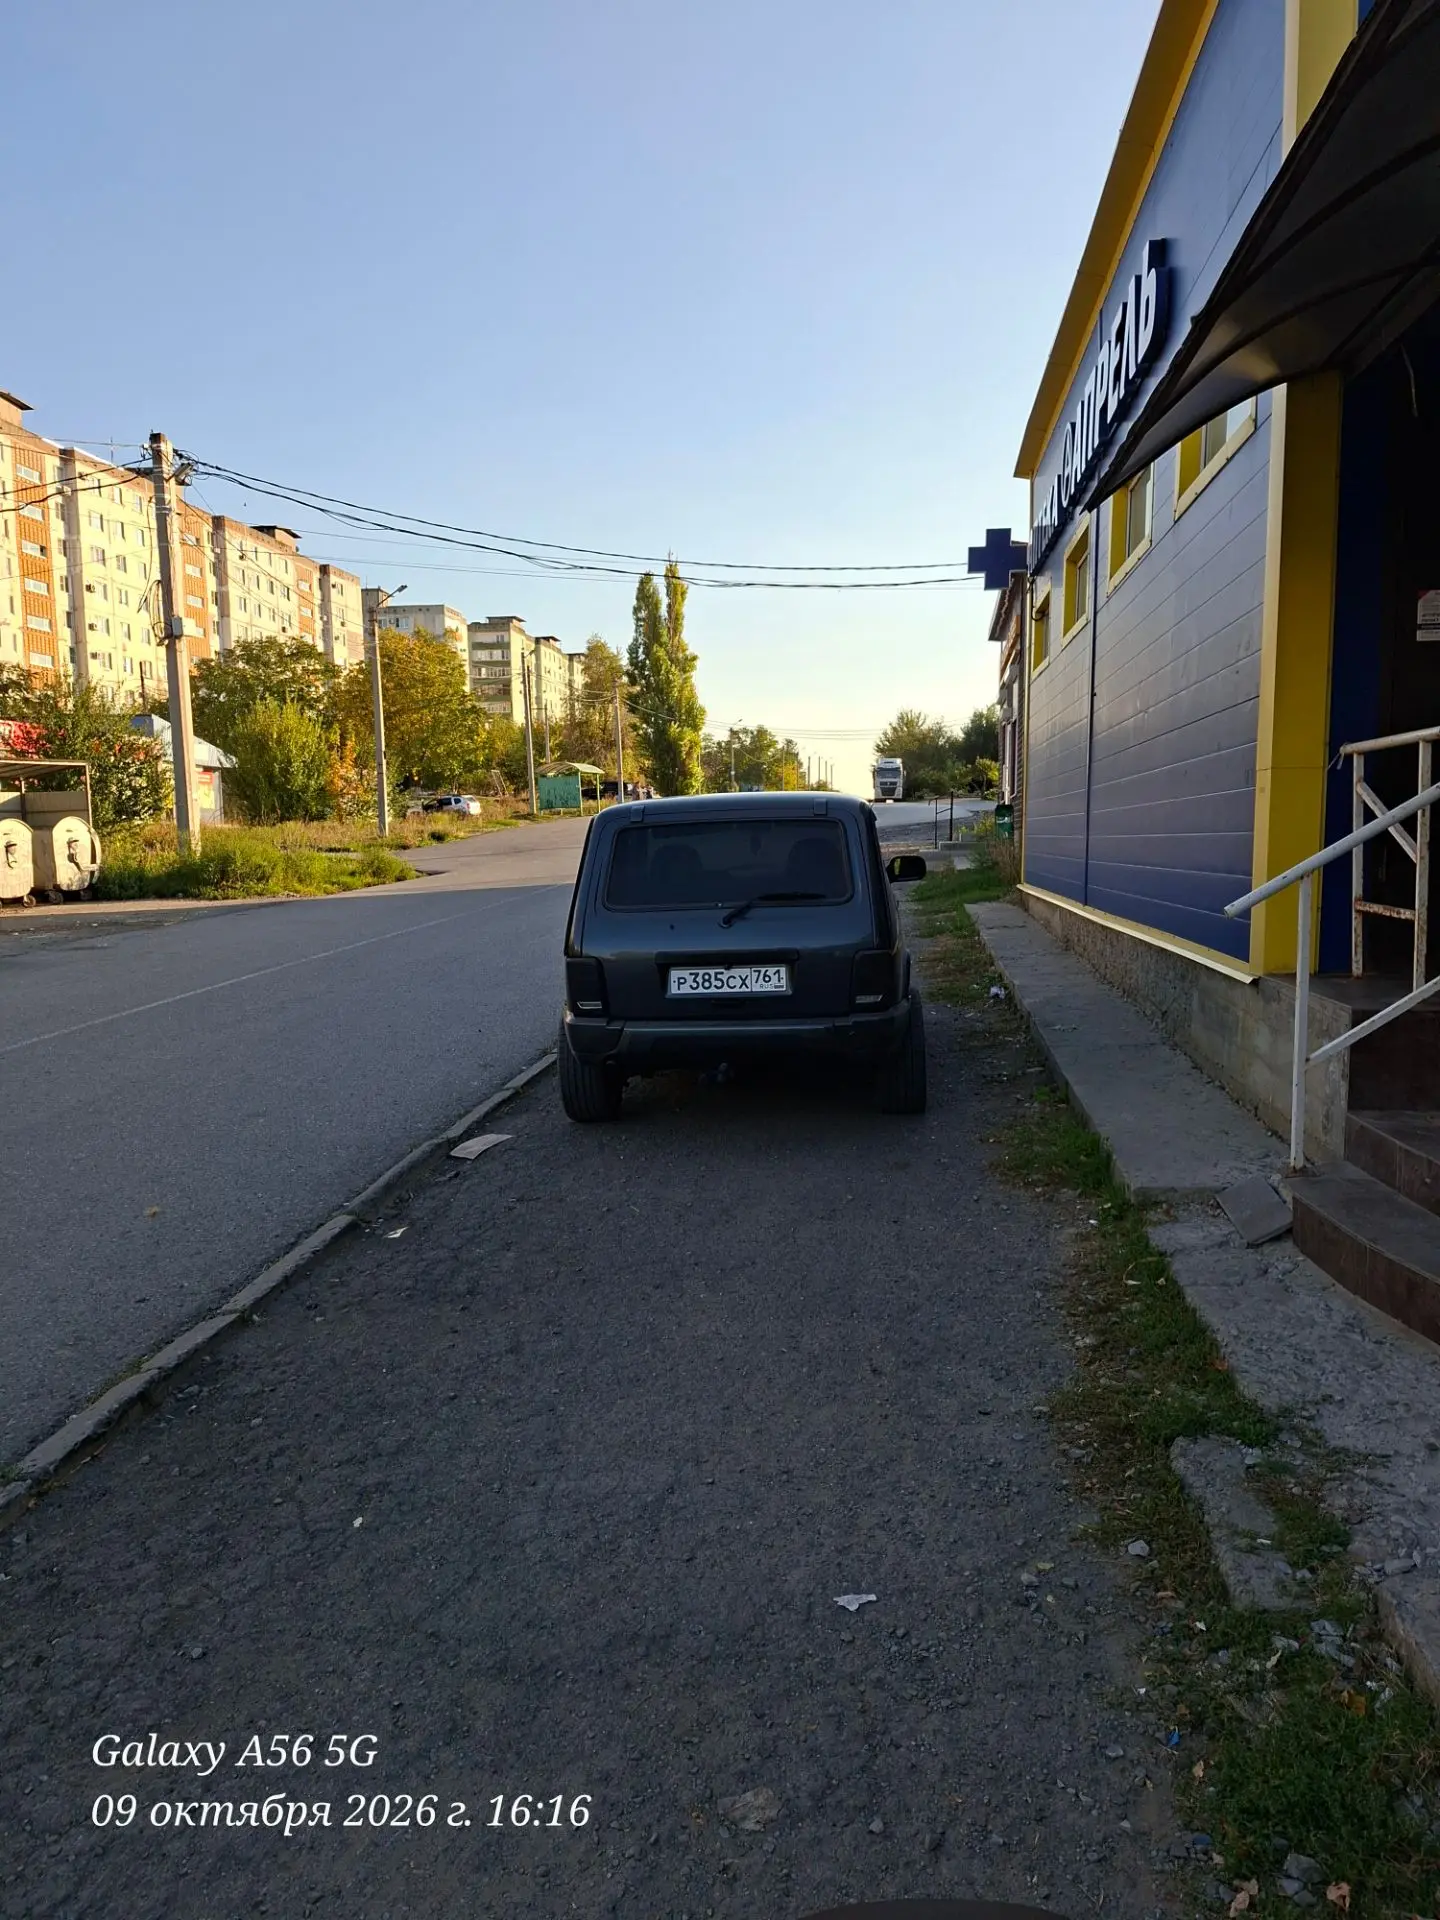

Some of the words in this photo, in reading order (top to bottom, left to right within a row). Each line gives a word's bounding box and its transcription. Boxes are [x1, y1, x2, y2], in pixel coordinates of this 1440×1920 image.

[1070, 239, 1159, 496] АПРЕЛЬ
[676, 971, 749, 991] Р385СХ
[753, 968, 780, 984] 761
